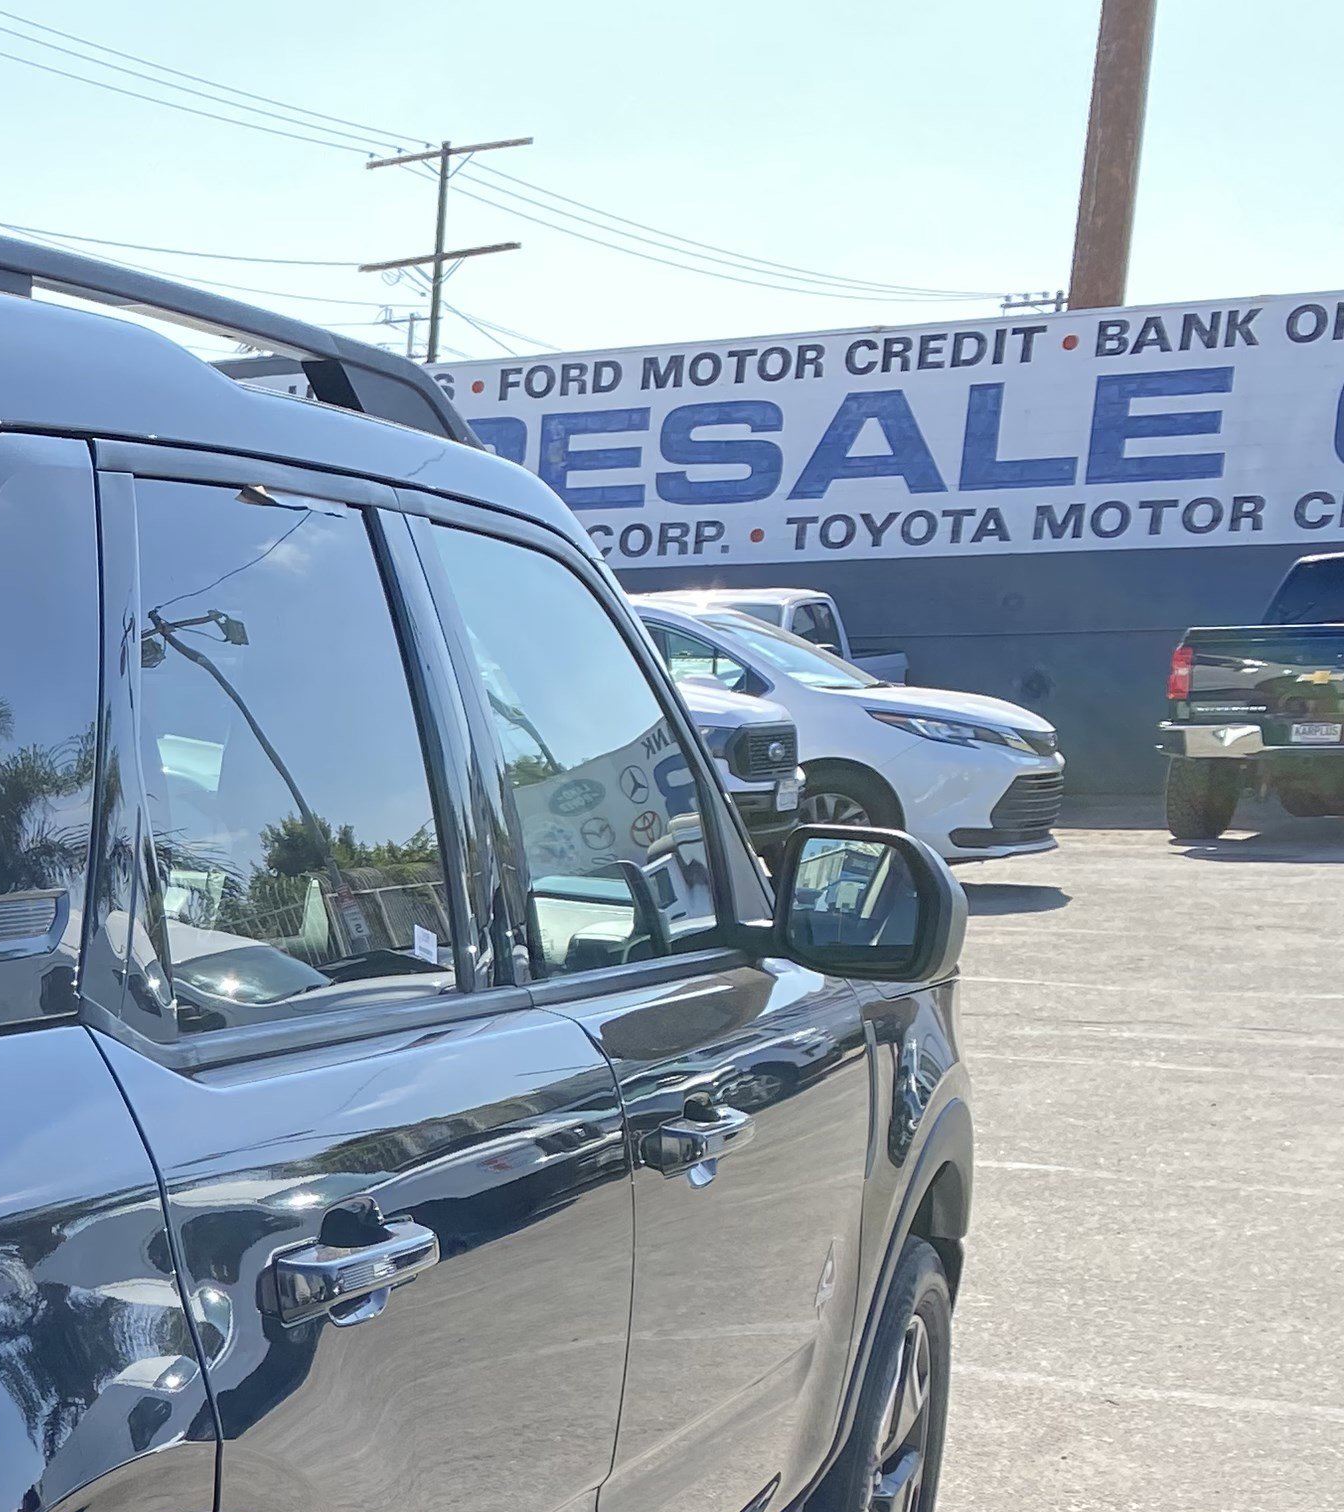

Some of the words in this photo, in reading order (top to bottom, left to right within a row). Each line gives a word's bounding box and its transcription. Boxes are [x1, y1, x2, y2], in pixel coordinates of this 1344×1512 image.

[498, 359, 623, 401] FORD
[640, 343, 825, 391] MOTOR
[844, 325, 1048, 376] CREDIT
[1095, 307, 1263, 358] BANK
[786, 507, 1012, 552] TOYOTA
[1032, 494, 1267, 541] MOTOR
